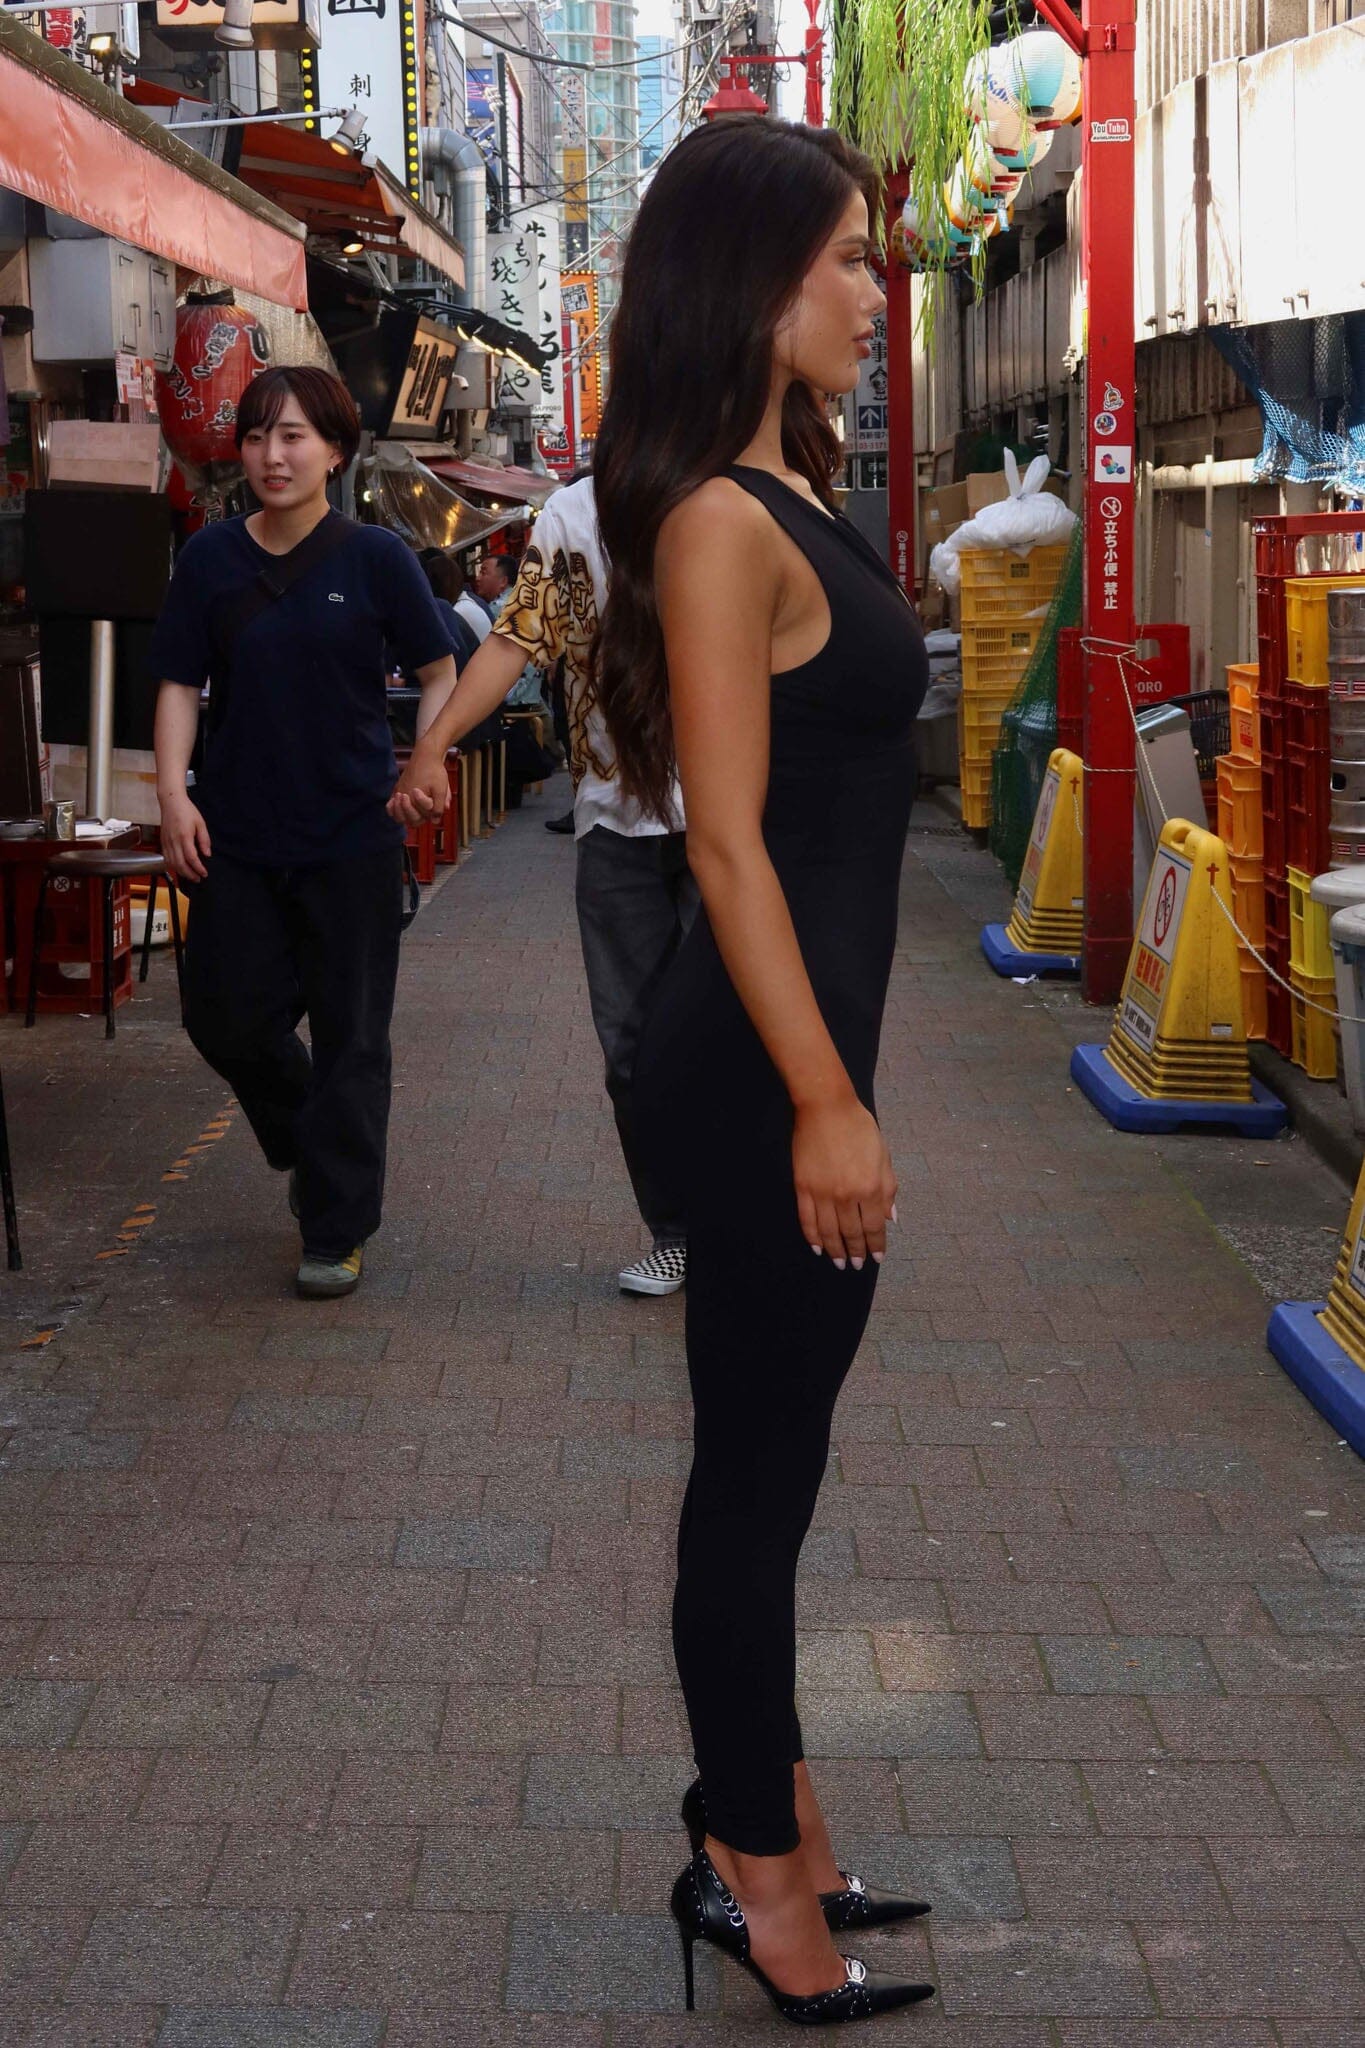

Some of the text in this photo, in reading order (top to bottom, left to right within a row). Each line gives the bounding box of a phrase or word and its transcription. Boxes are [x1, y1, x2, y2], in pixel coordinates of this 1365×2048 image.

[1104, 520, 1119, 610] 立ち小便 禁止
